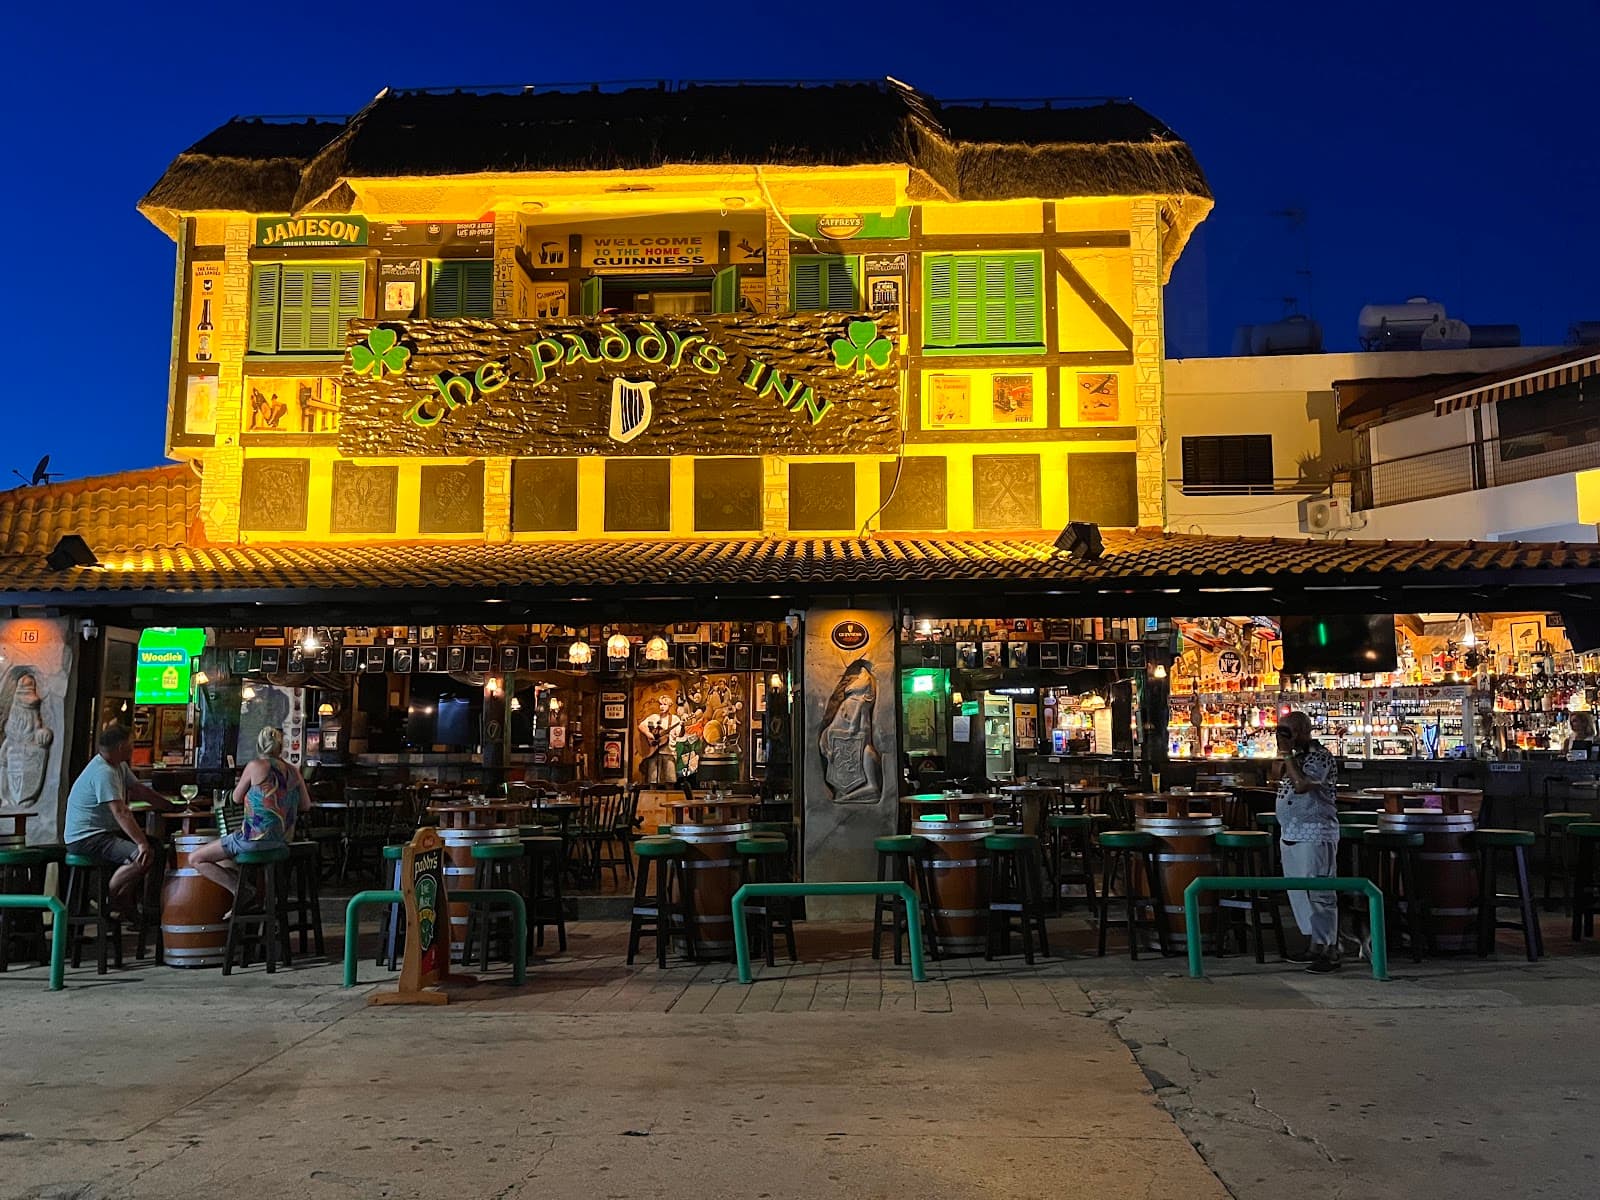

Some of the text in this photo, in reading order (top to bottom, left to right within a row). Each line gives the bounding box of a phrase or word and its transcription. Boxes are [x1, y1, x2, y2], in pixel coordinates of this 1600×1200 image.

[820, 218, 861, 226] CAFFREY'S
[262, 219, 360, 245] JAMESON
[594, 236, 703, 248] WELCOME
[616, 248, 640, 256] THE
[645, 247, 680, 256] HOME
[686, 247, 702, 255] OF
[593, 256, 705, 266] GUINNESS
[24, 631, 35, 641] 16
[141, 651, 183, 662] Woodie's
